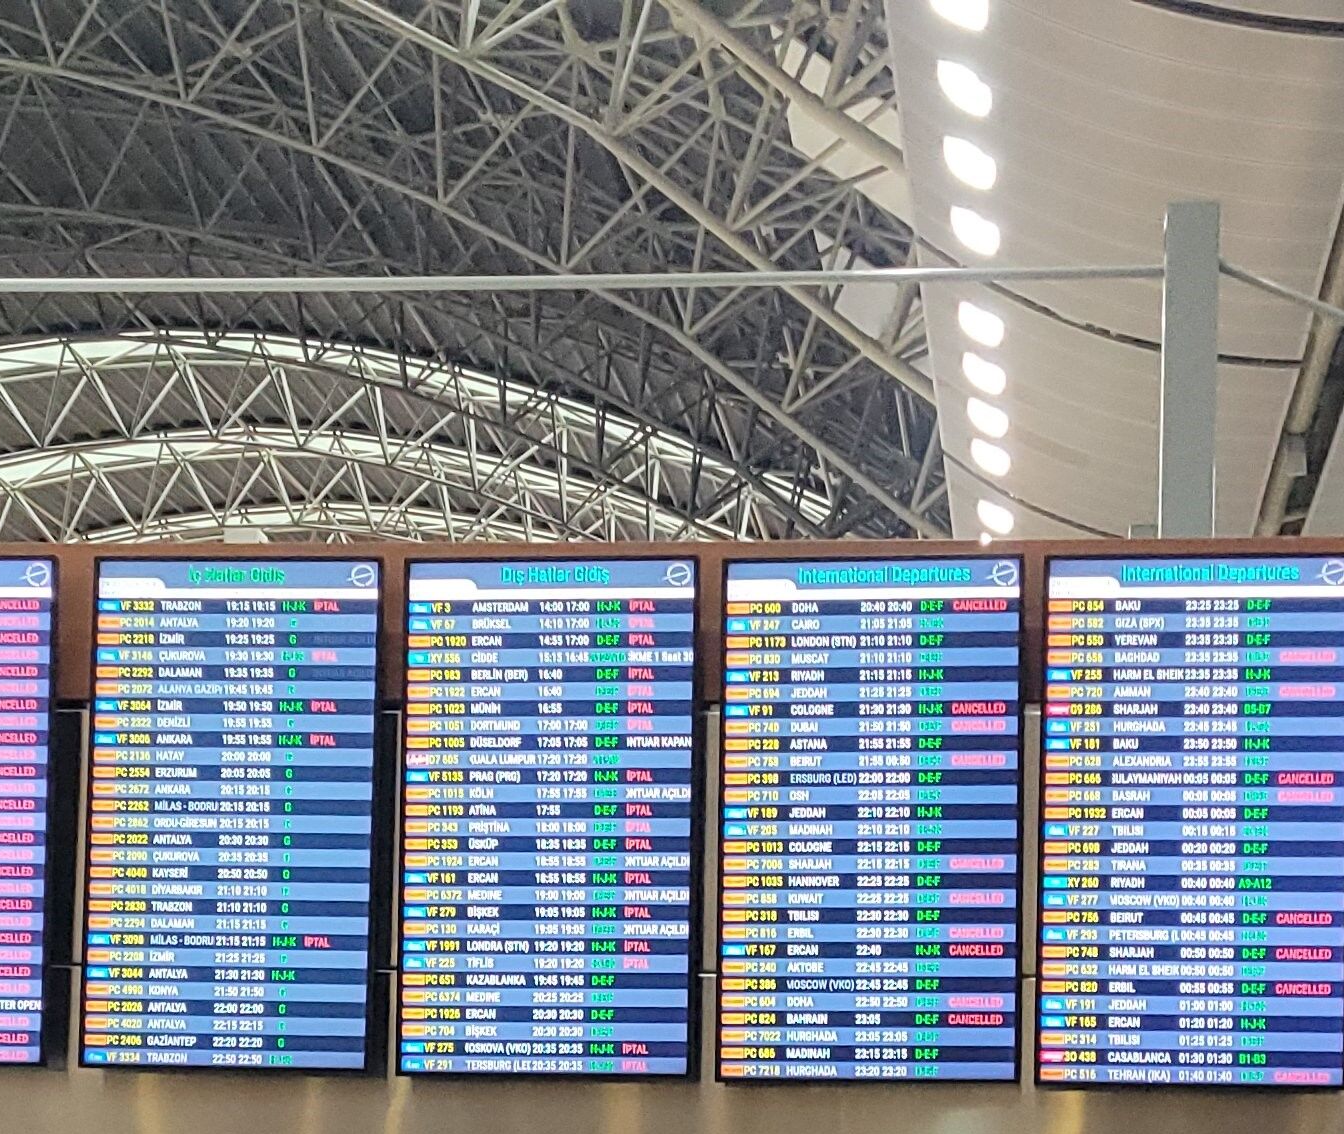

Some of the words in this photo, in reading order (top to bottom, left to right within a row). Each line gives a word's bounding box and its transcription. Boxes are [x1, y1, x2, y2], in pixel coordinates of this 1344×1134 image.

[501, 567, 524, 584] Dış
[529, 567, 570, 582] Hatlar
[574, 566, 610, 584] Gidiş
[799, 566, 888, 583] International
[892, 566, 971, 584] Departures
[1122, 565, 1214, 582] International
[1218, 564, 1300, 583] Departures
[161, 601, 201, 611] TRABZON
[314, 599, 339, 611] İPTAL
[472, 602, 528, 612] AMSTERDAM
[629, 599, 655, 611] İPTAL
[792, 602, 818, 612] DOHA
[952, 600, 1007, 611] CANCELLED
[1115, 600, 1141, 611] BAKU
[472, 636, 502, 646] ERCAN
[792, 636, 829, 647] LONDON
[1114, 634, 1157, 646] YEREVAN
[159, 667, 202, 678] DALAMAN
[471, 668, 503, 680] BERLİN
[791, 671, 825, 681] RIYADH
[790, 705, 834, 716] COLOGNE
[951, 703, 1006, 714] CANCELLED
[1114, 704, 1158, 714] SHARJAH
[156, 734, 192, 745] ANKARA
[1112, 756, 1172, 767] ALEXANDRIA
[155, 767, 197, 778] ERZURUM
[153, 835, 192, 845] ANTALYA
[1111, 843, 1149, 854] JEDDAH
[152, 866, 188, 878] KAYSERİ
[468, 873, 498, 884] ERCAN
[788, 876, 839, 887] HANNOVER
[1110, 878, 1145, 889] RIYADH
[151, 901, 192, 912] TRABZON
[1110, 913, 1143, 923] BEIRUT
[1276, 913, 1332, 924] CANCELLED
[787, 1014, 828, 1025] BAHRAIN
[147, 1034, 196, 1048] GAZİANTEP
[786, 1048, 830, 1059] MADINAH
[1108, 1053, 1171, 1064] CASABLANCA
[1108, 1070, 1146, 1081] TEHRAN
